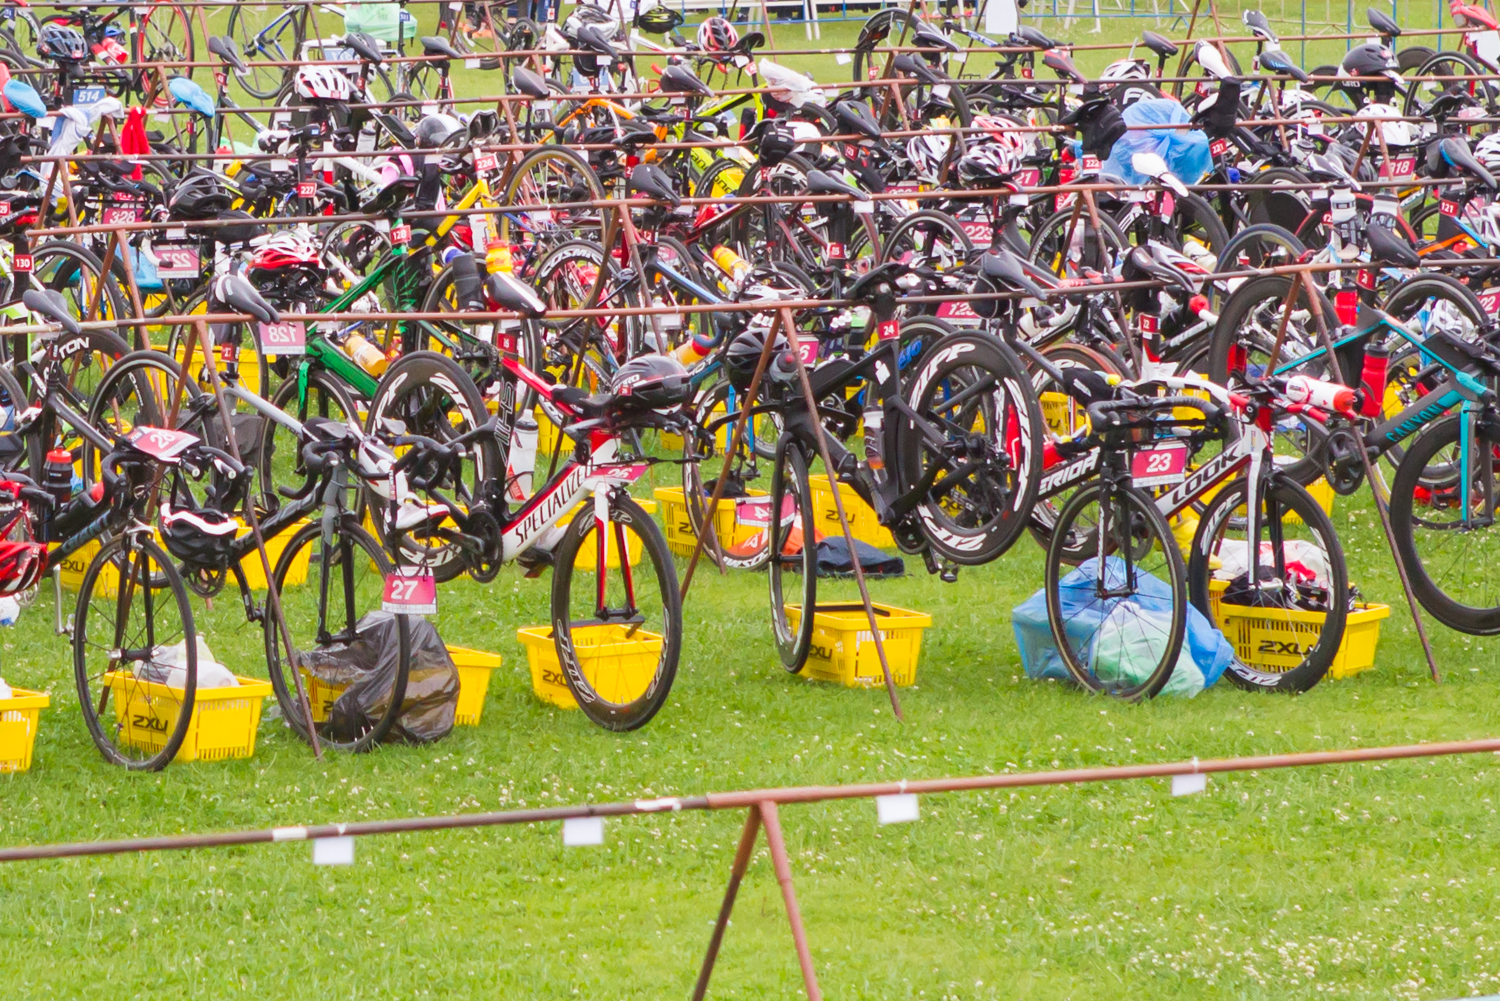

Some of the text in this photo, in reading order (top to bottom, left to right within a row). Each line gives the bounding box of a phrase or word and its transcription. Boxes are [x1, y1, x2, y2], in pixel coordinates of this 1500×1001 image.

[77, 90, 100, 102] 514
[301, 185, 314, 195] 227
[16, 258, 30, 268] 130
[883, 324, 895, 336] 24
[1386, 404, 1444, 442] CANYON
[149, 431, 176, 449] 28
[1038, 446, 1100, 495] ERIDA
[1146, 453, 1172, 474] 23
[1172, 448, 1240, 505] LOOK
[390, 580, 419, 600] 27
[132, 714, 169, 731] 2XU
